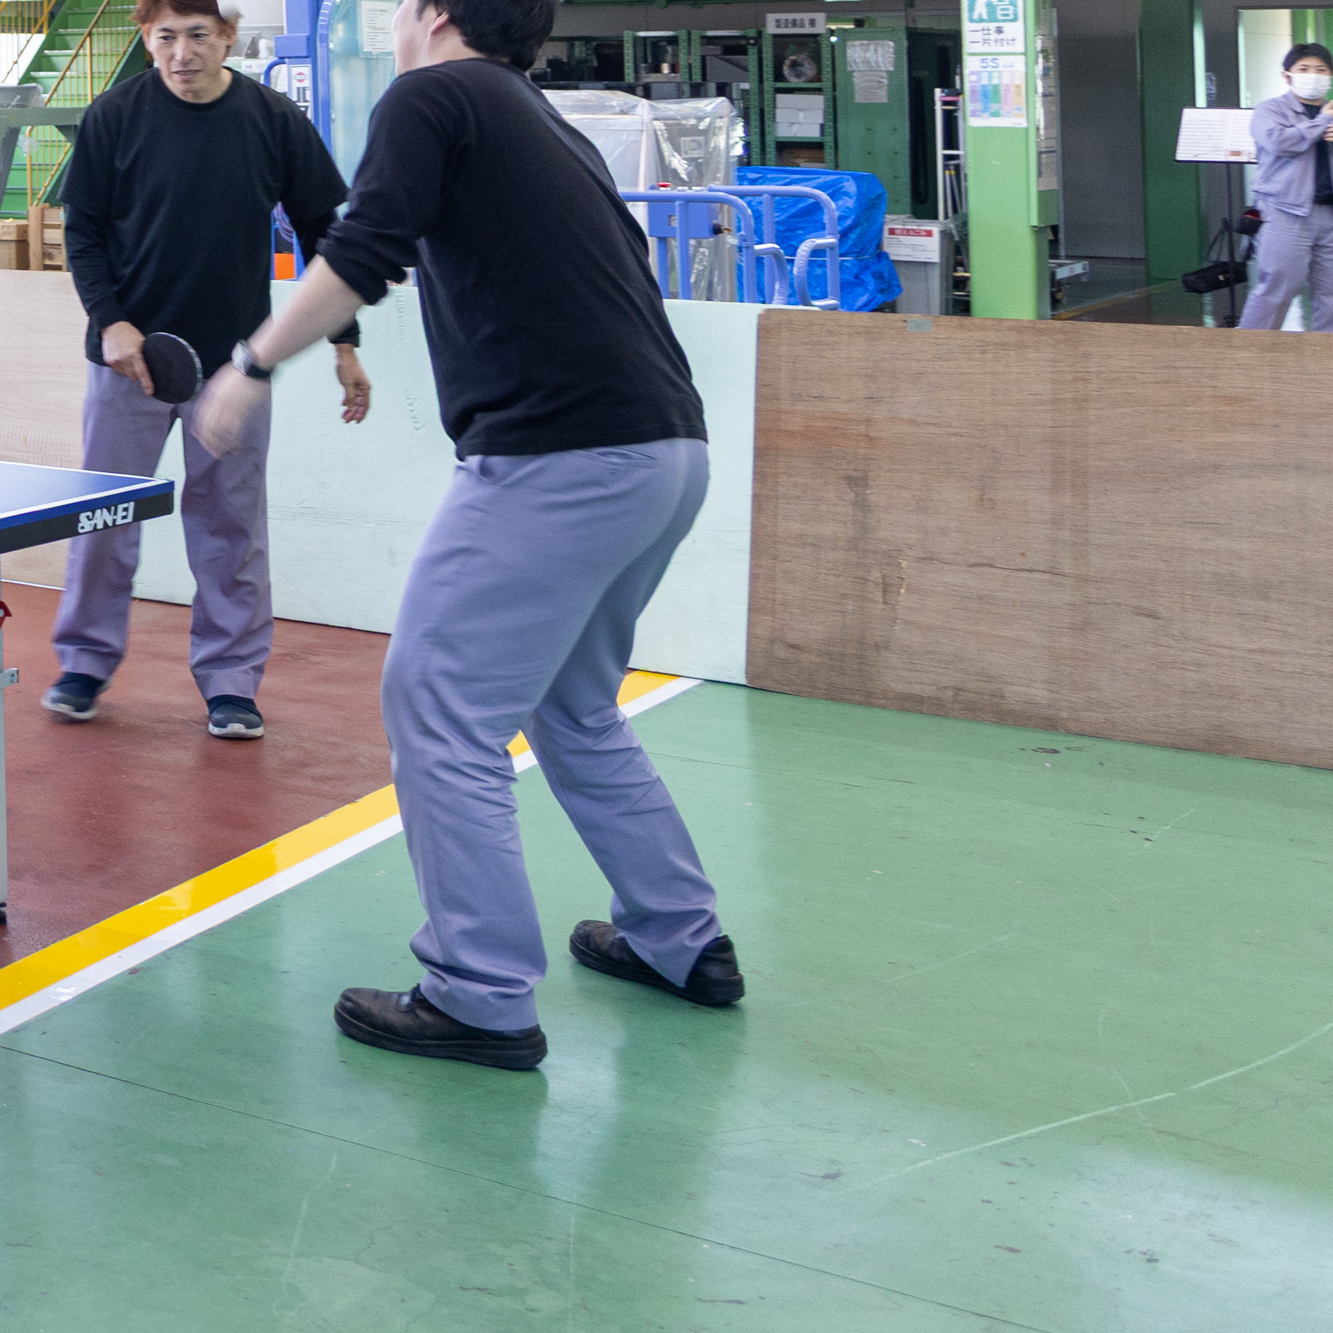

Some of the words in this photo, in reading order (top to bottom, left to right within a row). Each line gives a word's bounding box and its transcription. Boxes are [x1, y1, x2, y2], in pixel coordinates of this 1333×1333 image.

[969, 26, 1005, 35] 一仕事
[969, 37, 1017, 47] 一片付け
[980, 57, 1001, 69] 5S
